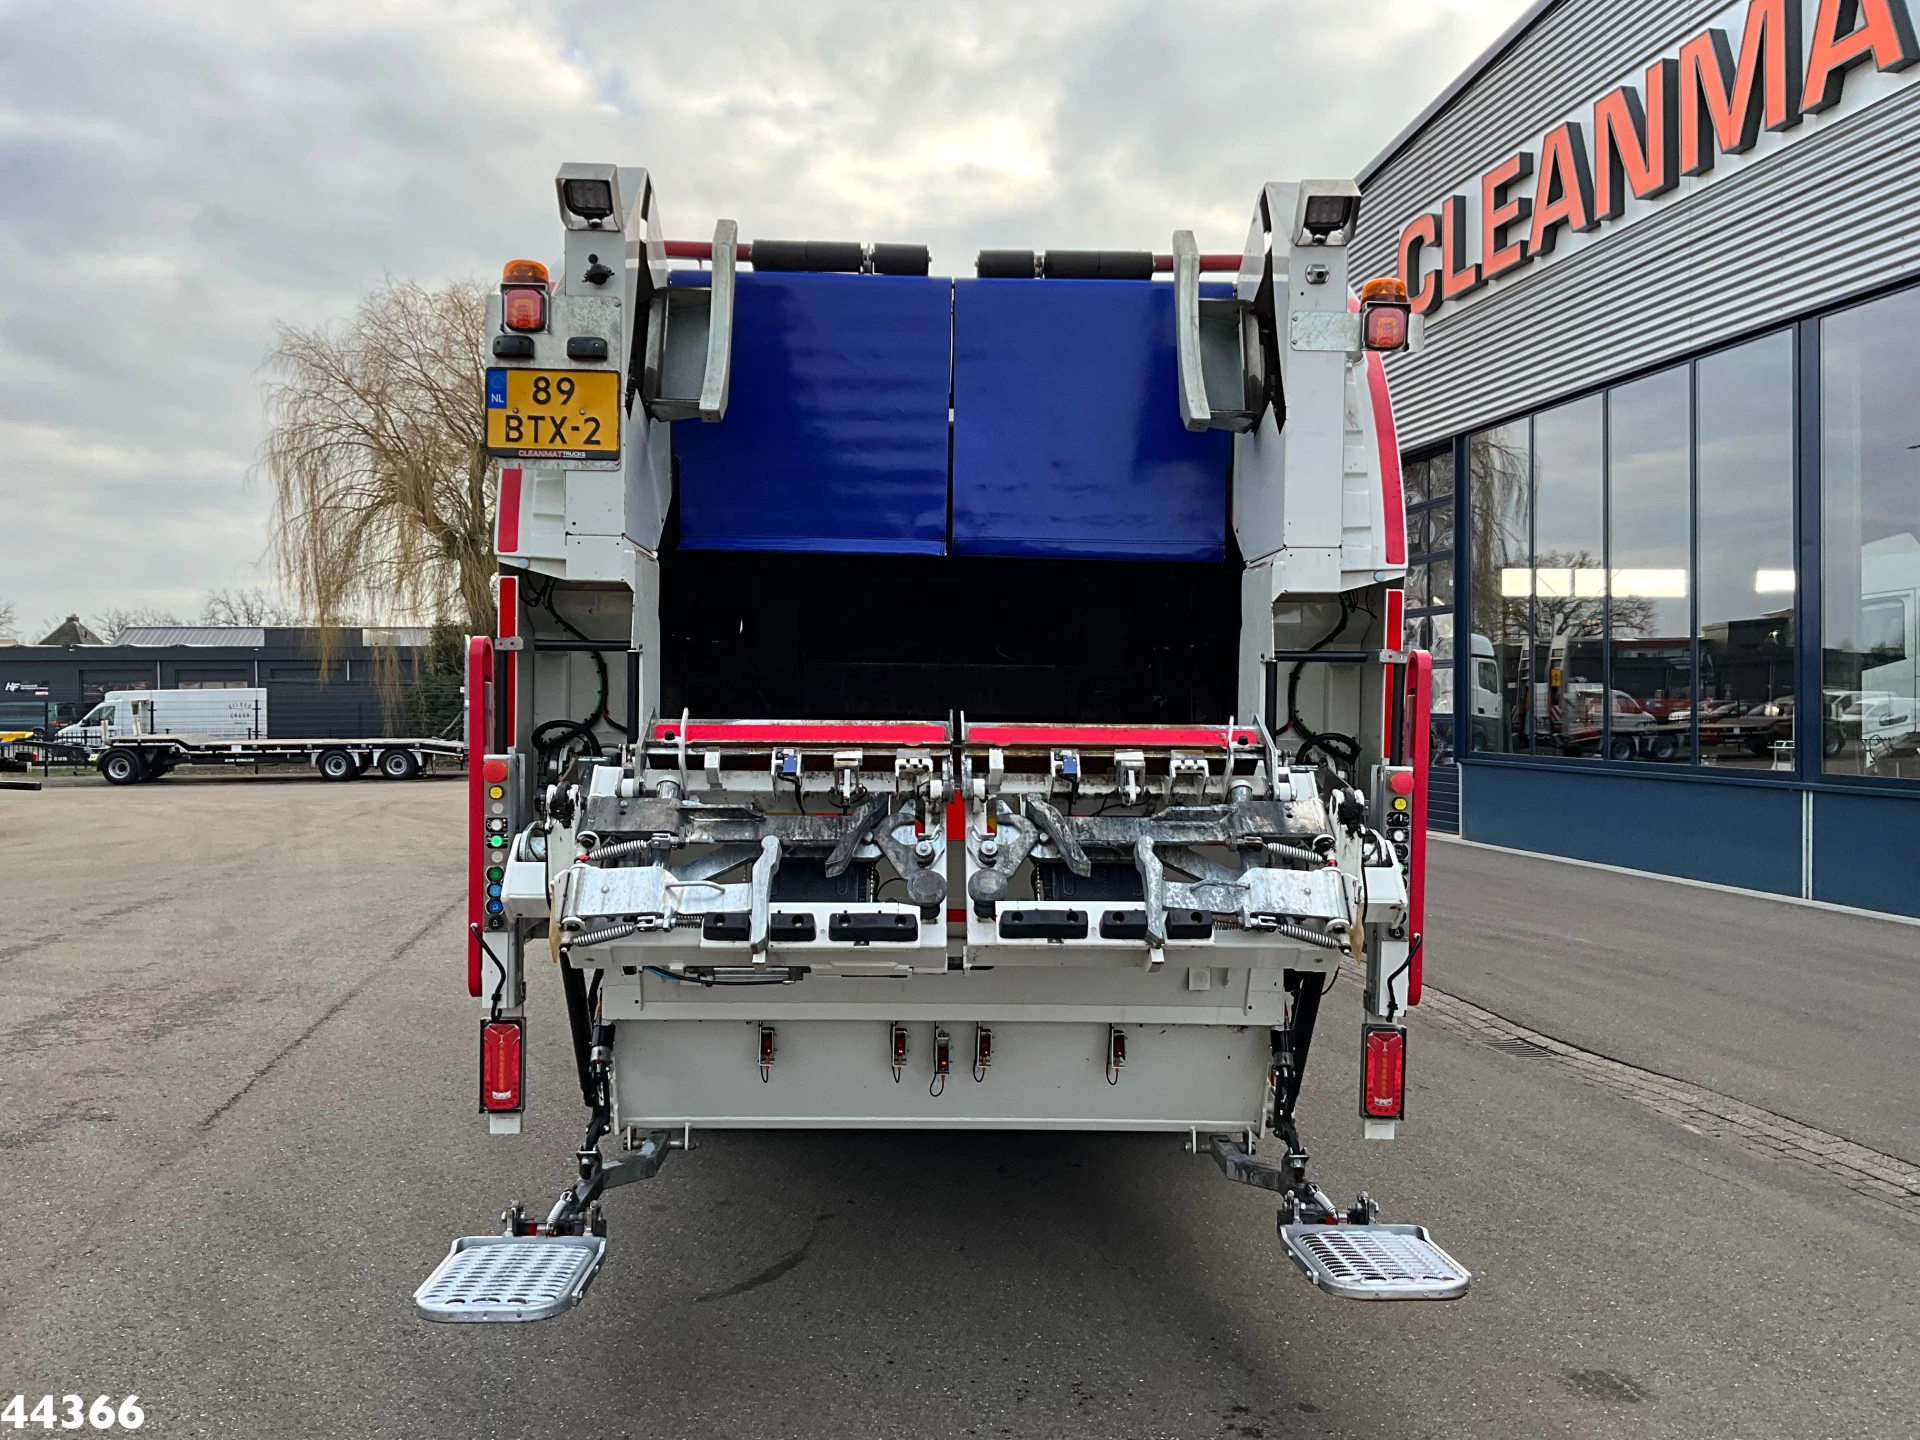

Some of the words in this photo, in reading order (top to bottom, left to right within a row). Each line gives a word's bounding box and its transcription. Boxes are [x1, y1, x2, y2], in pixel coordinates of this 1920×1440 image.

[1397, 0, 1918, 314] CLEANMA
[491, 393, 505, 403] NL
[532, 376, 575, 405] 89
[505, 415, 601, 445] BTX-2
[4, 681, 21, 691] HF
